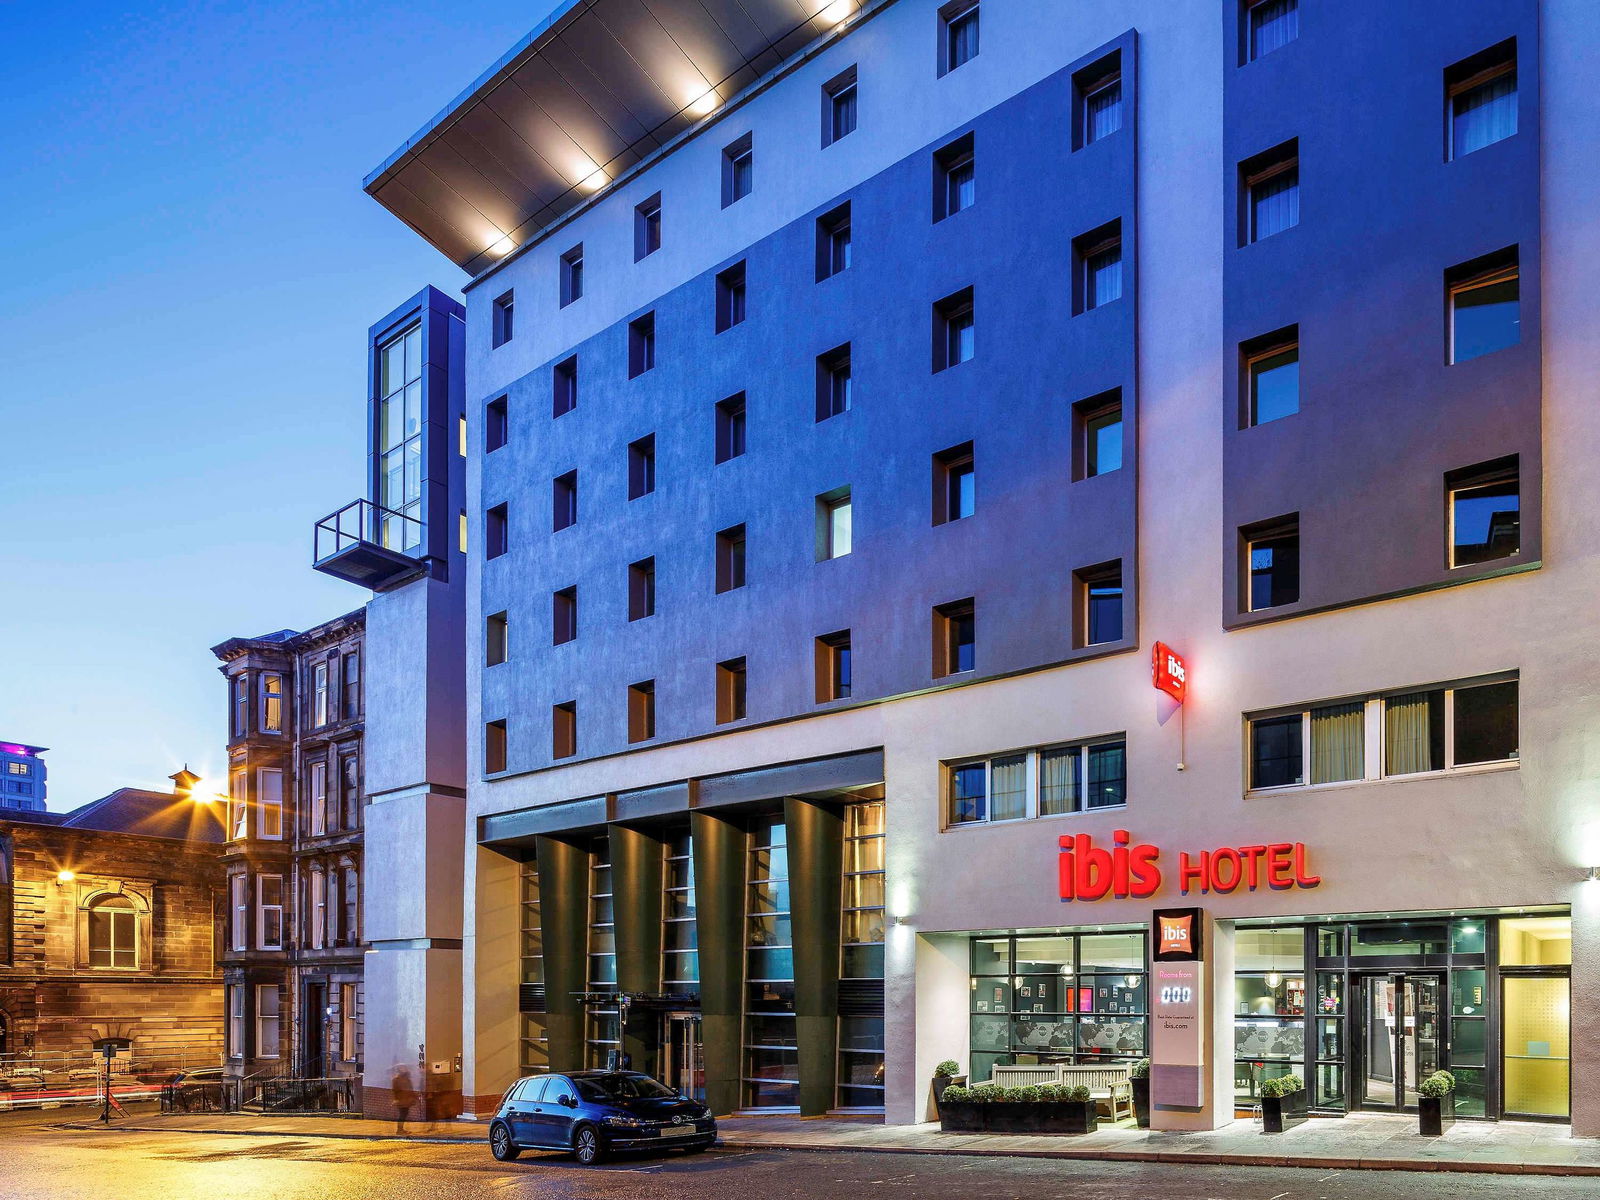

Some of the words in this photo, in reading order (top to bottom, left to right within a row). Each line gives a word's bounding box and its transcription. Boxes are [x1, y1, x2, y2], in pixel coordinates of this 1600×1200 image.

[1167, 655, 1185, 683] ibis
[1059, 830, 1161, 902] ibis
[1180, 842, 1321, 896] HOTEL
[1164, 925, 1187, 940] ibis
[1160, 970, 1178, 978] Rooms
[1179, 969, 1192, 978] from
[1164, 1021, 1188, 1029] ibis.com
